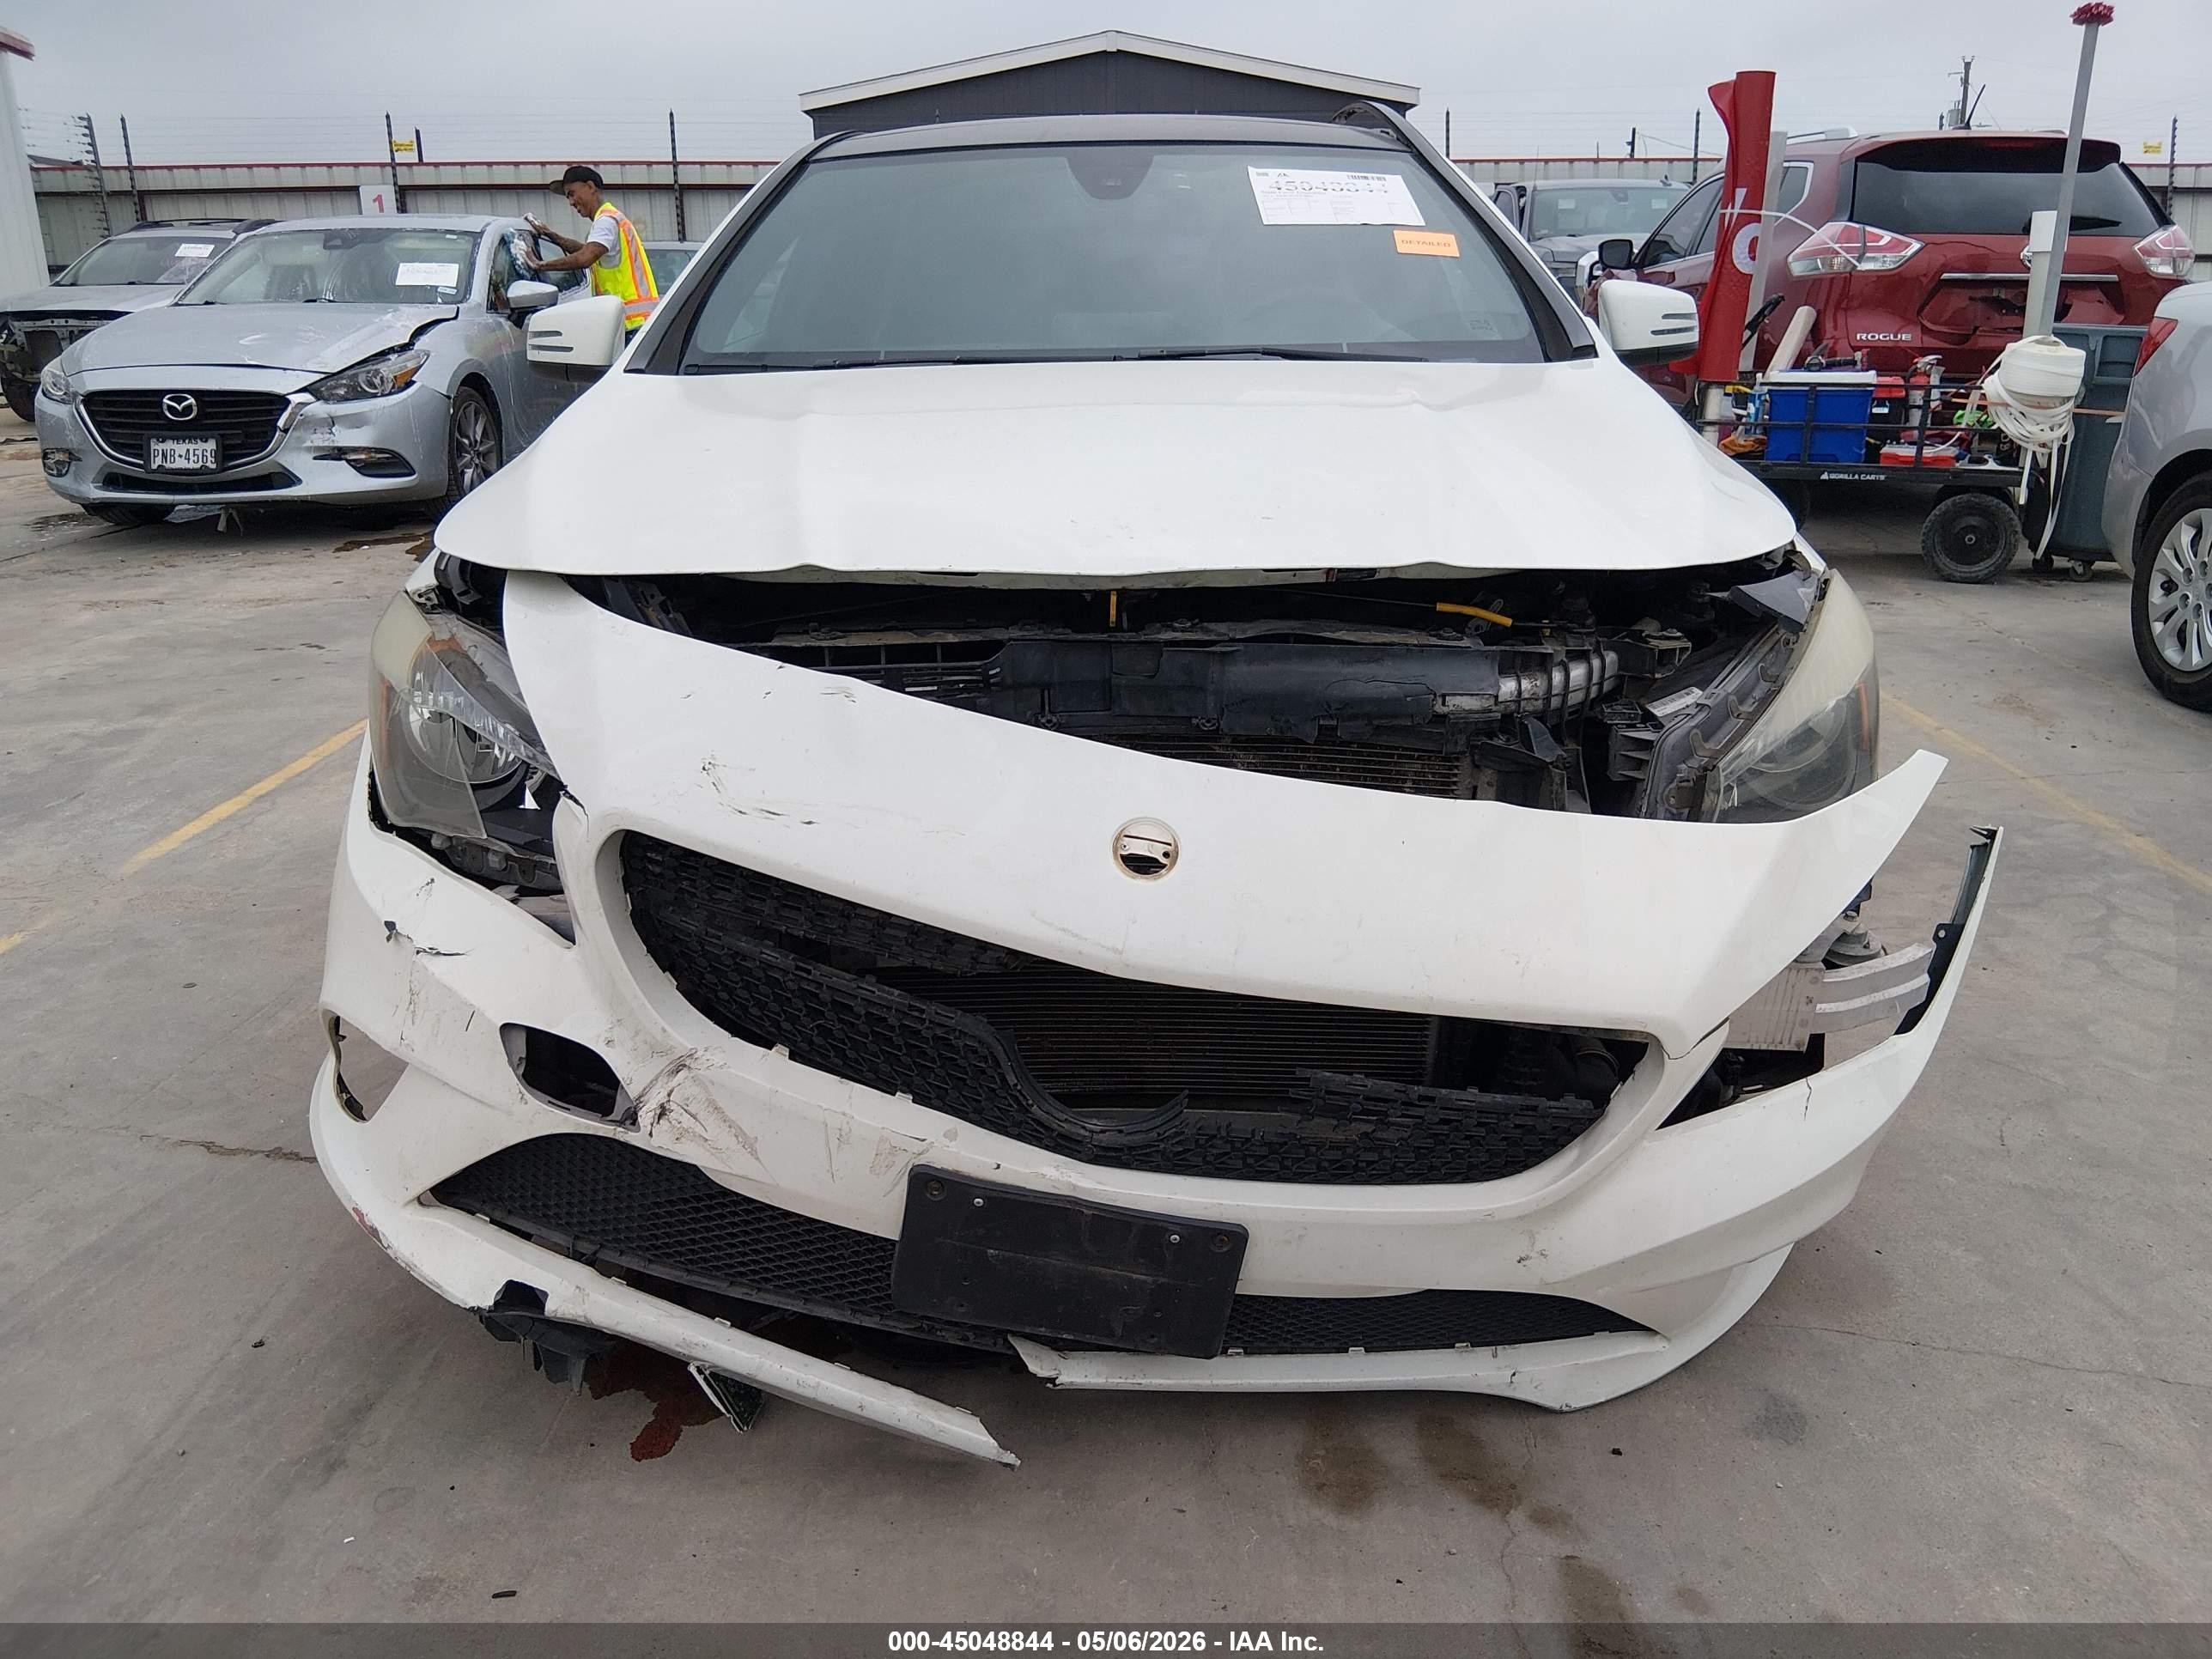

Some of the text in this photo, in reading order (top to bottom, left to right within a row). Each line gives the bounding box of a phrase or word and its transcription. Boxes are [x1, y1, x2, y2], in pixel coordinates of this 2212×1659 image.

[372, 193, 385, 214] 1
[1401, 240, 1451, 248] DETAILED
[1856, 332, 1912, 341] ROGUE
[1828, 472, 1859, 481] GORILLA
